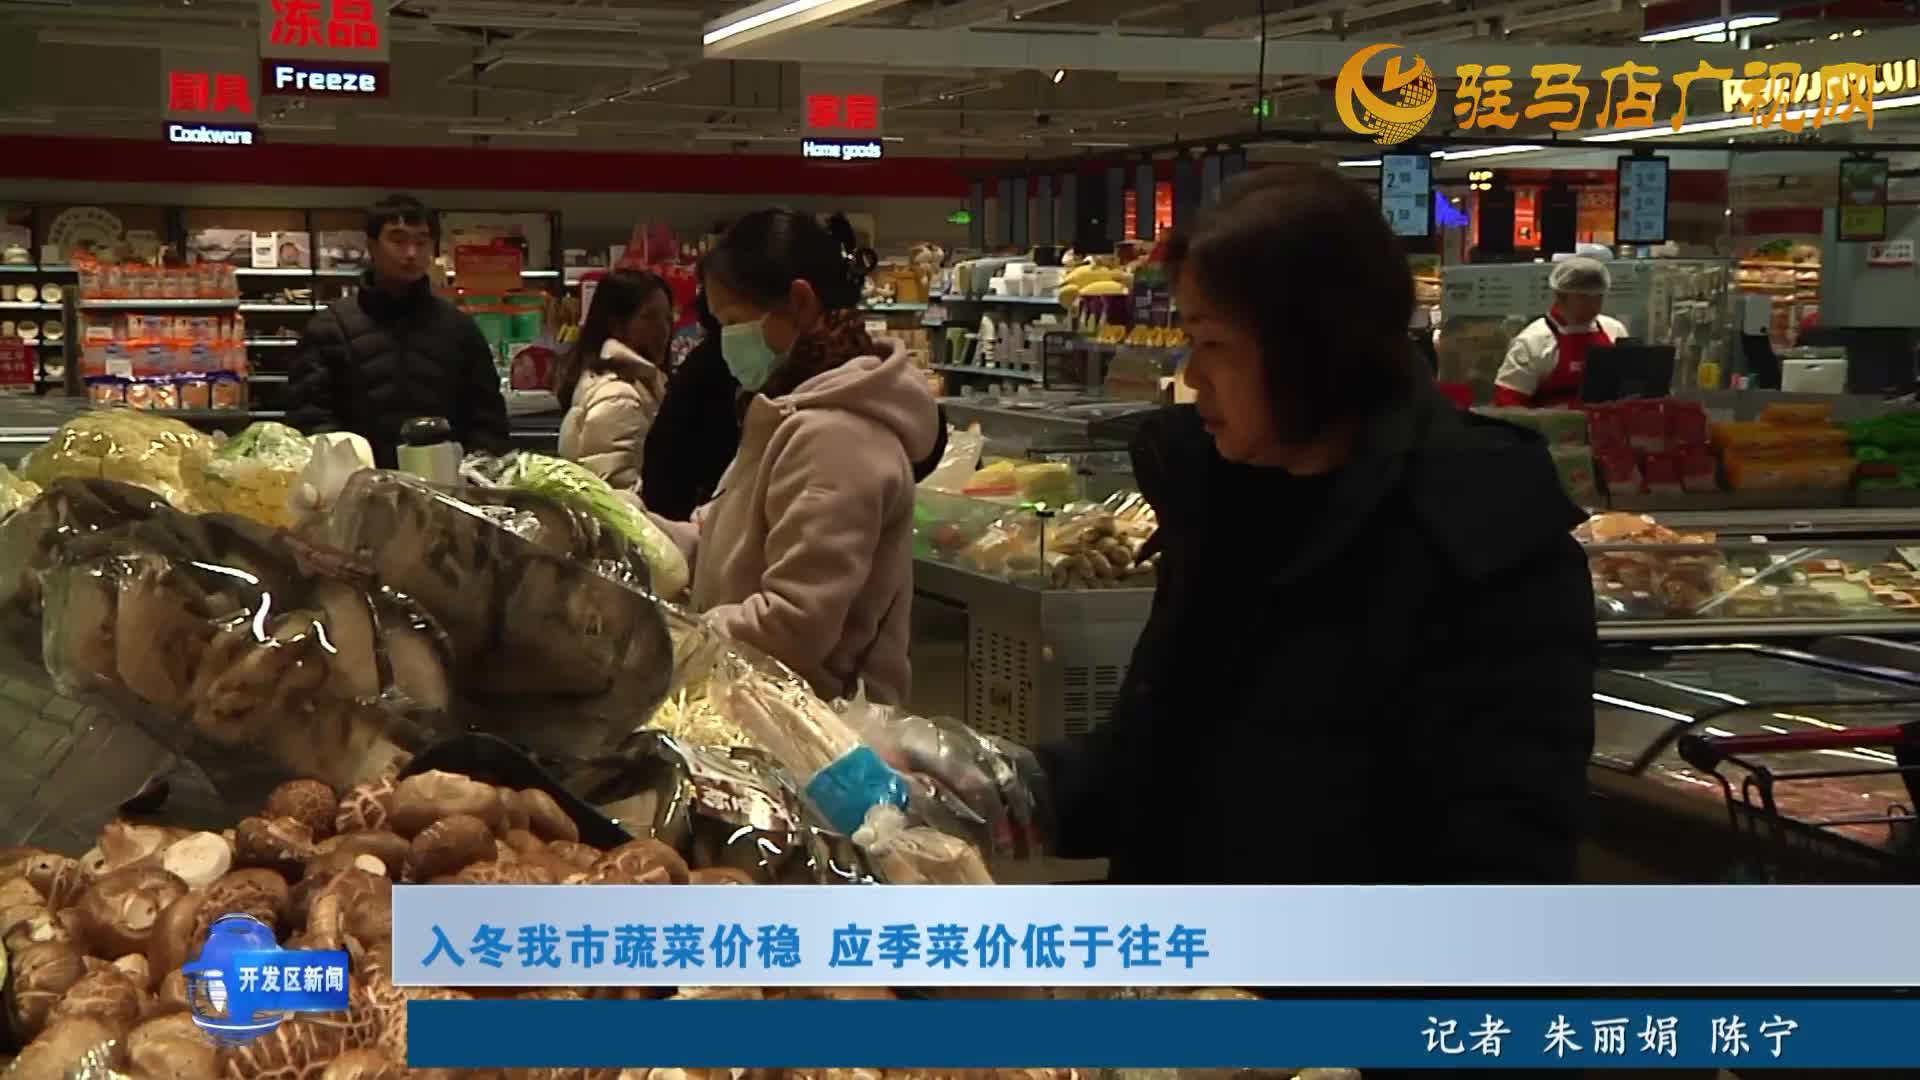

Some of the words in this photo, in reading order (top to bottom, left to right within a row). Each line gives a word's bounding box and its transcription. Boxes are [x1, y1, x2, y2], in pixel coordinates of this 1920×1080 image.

[269, 0, 379, 49] 冻品
[276, 66, 376, 92] Freeze
[168, 72, 252, 113] 厨具
[169, 125, 253, 145] Cookware
[803, 141, 840, 157] Home
[842, 142, 882, 160] goods
